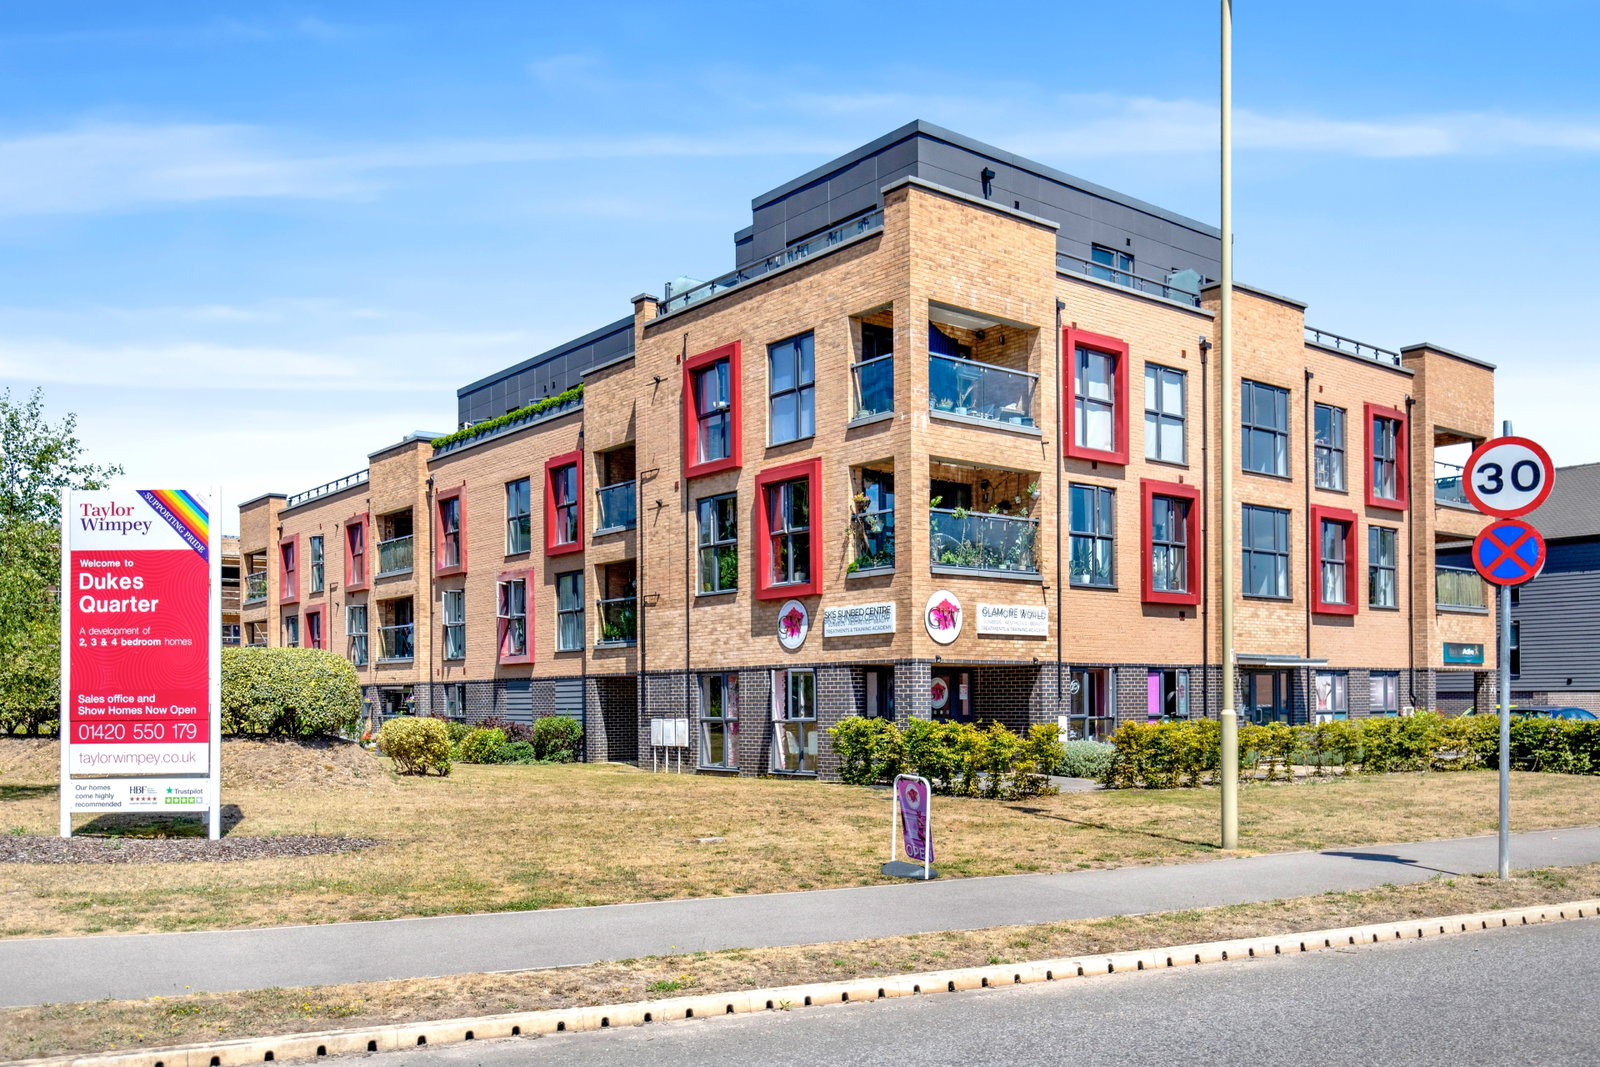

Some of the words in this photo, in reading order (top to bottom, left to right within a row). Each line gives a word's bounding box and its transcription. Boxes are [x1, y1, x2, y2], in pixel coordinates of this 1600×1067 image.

[1476, 459, 1541, 495] 30
[79, 501, 135, 520] Taylor
[80, 517, 152, 535] Wimpey
[144, 492, 186, 533] SUPPORTING
[183, 531, 206, 554] PRIDE
[79, 559, 121, 568] Welcome
[124, 559, 134, 568] to
[79, 572, 144, 590] Dukes
[79, 595, 159, 613] Quarter
[837, 607, 865, 618] SUNBED
[865, 605, 892, 616] CENTRE
[1019, 608, 1047, 620] WORLD
[79, 627, 86, 635] A
[88, 626, 139, 637] development
[142, 626, 151, 635] of
[79, 638, 88, 647] 2,
[90, 638, 97, 646] 3
[100, 638, 107, 646] &
[111, 638, 117, 646] 4
[121, 637, 162, 646] bedroom
[164, 637, 193, 646] homes
[78, 694, 105, 704] Sales
[107, 694, 135, 703] office
[137, 694, 156, 703] and
[78, 706, 106, 715] Show
[108, 706, 143, 715] Homes
[145, 706, 167, 715] Now
[170, 705, 197, 716] Open
[78, 723, 126, 740] 01420
[133, 723, 165, 740] 550
[172, 723, 197, 739] 179
[79, 751, 197, 766] taylorwimpey.co.uk
[129, 785, 148, 795] HBF
[174, 788, 204, 796] Trustpilot
[94, 792, 115, 801] highly
